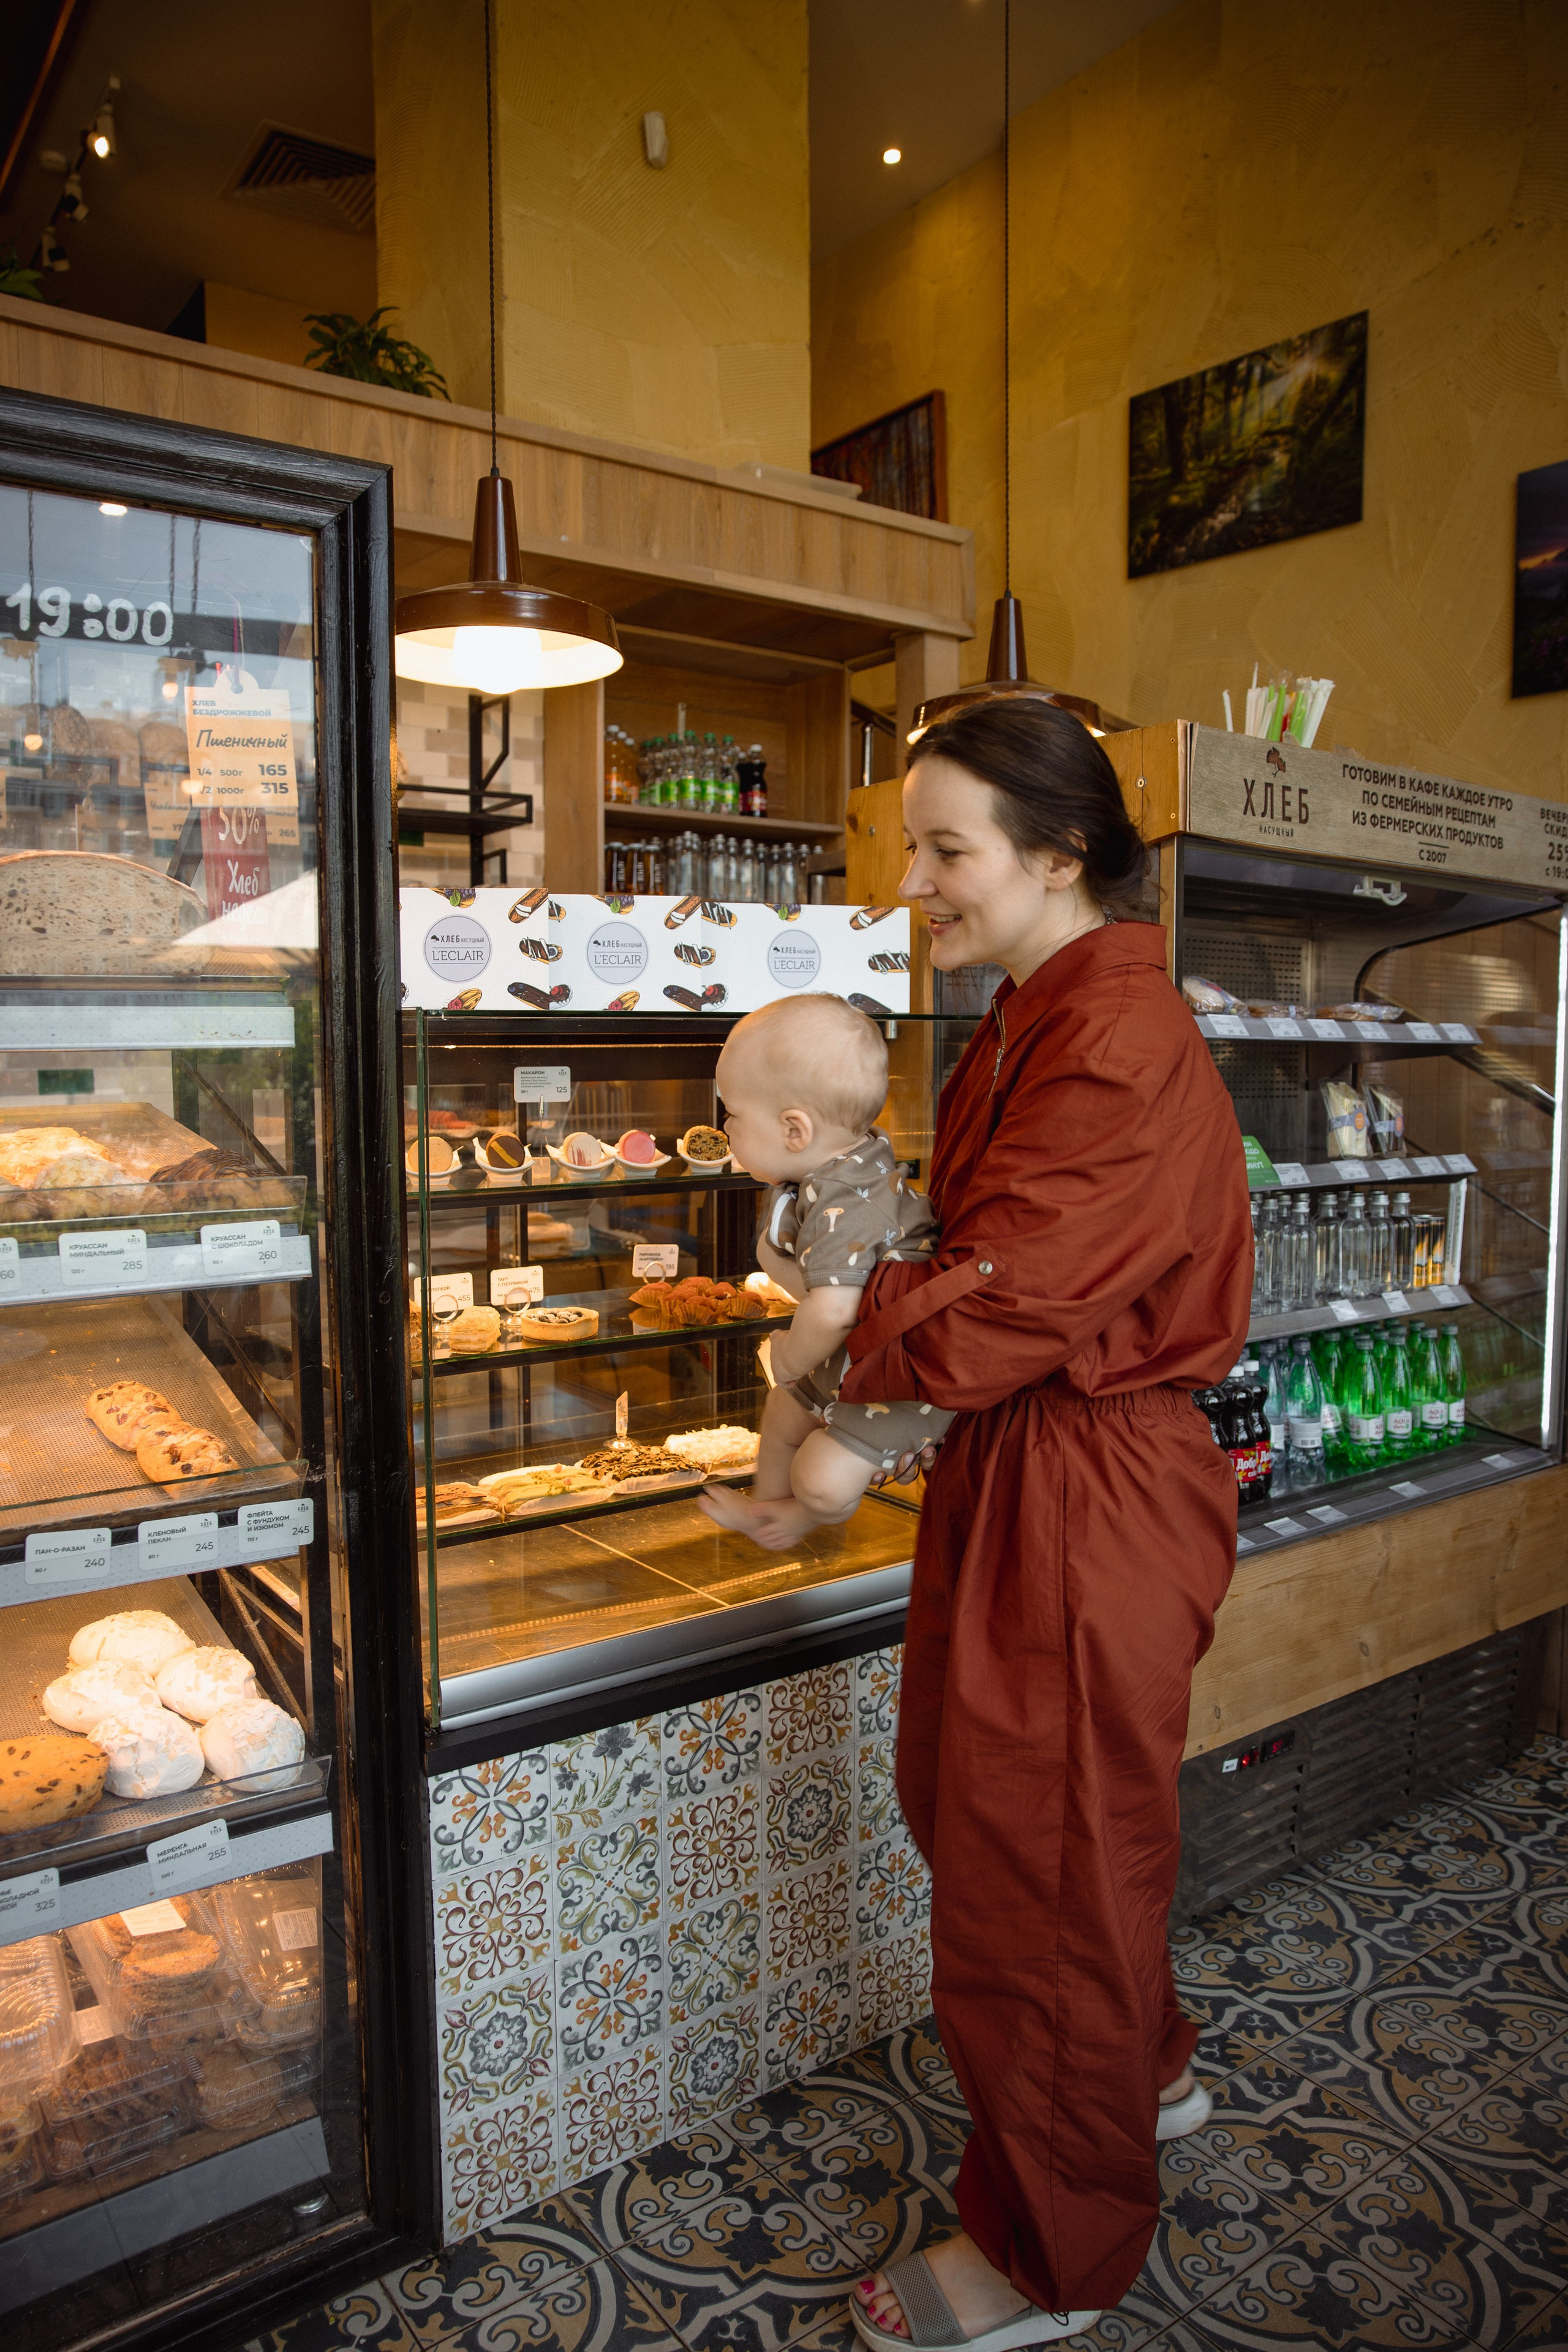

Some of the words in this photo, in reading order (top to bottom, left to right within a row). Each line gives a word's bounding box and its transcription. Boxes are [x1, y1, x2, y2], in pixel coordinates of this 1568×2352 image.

[6, 582, 174, 646] 19:00
[196, 729, 288, 748] Пшеничный
[197, 767, 212, 776] 1/4
[258, 764, 287, 776] 165
[261, 782, 289, 794] 315
[1342, 764, 1396, 788] ГОТОВИМ
[1399, 775, 1406, 790] В
[1409, 777, 1439, 796] КАФЕ
[1442, 783, 1485, 806] КАЖДОЕ
[1488, 794, 1513, 812] УТРО
[1243, 778, 1310, 824] ХЛЕБ
[1362, 790, 1378, 806] ПО
[1382, 794, 1443, 818] СЕМЕЙНЫМ
[1446, 805, 1496, 828] РЕЦЕПТАМ
[278, 829, 296, 838] 265
[1259, 825, 1294, 837] НАСУЩНЫЙ
[1352, 810, 1367, 826] ИЗ
[1370, 813, 1444, 839] ФЕРМЕРСКИХ
[1446, 827, 1504, 850] ПРОДУКТОВ
[1419, 849, 1425, 861] С
[1426, 851, 1447, 864] 2007
[227, 859, 260, 896] Хлеб
[432, 950, 484, 961] L'ECLAIR
[594, 954, 642, 965] L'ECLAIR
[774, 960, 815, 970] L'ECLAIR
[217, 1239, 263, 1250] ШОКОЛАДОМ
[69, 1248, 125, 1258] МИНДАЛЬНЫЙ
[258, 1250, 277, 1260] 260
[123, 1260, 143, 1270] 285
[253, 1515, 290, 1525] ФУНДУКОМ
[148, 1526, 186, 1537] КЛЕНОВЫЙ
[254, 1523, 284, 1531] ИЗЮМОМ
[292, 1526, 310, 1536] 245
[35, 1545, 86, 1555] ПАН-О-РАЗАН
[195, 1541, 214, 1552] 245
[85, 1558, 105, 1568] 240
[157, 1842, 188, 1858] МЕРЕНГА
[158, 1842, 207, 1864] МИНДАЛЬНАЯ
[208, 1847, 227, 1861] 255
[35, 1898, 56, 1912] 325
